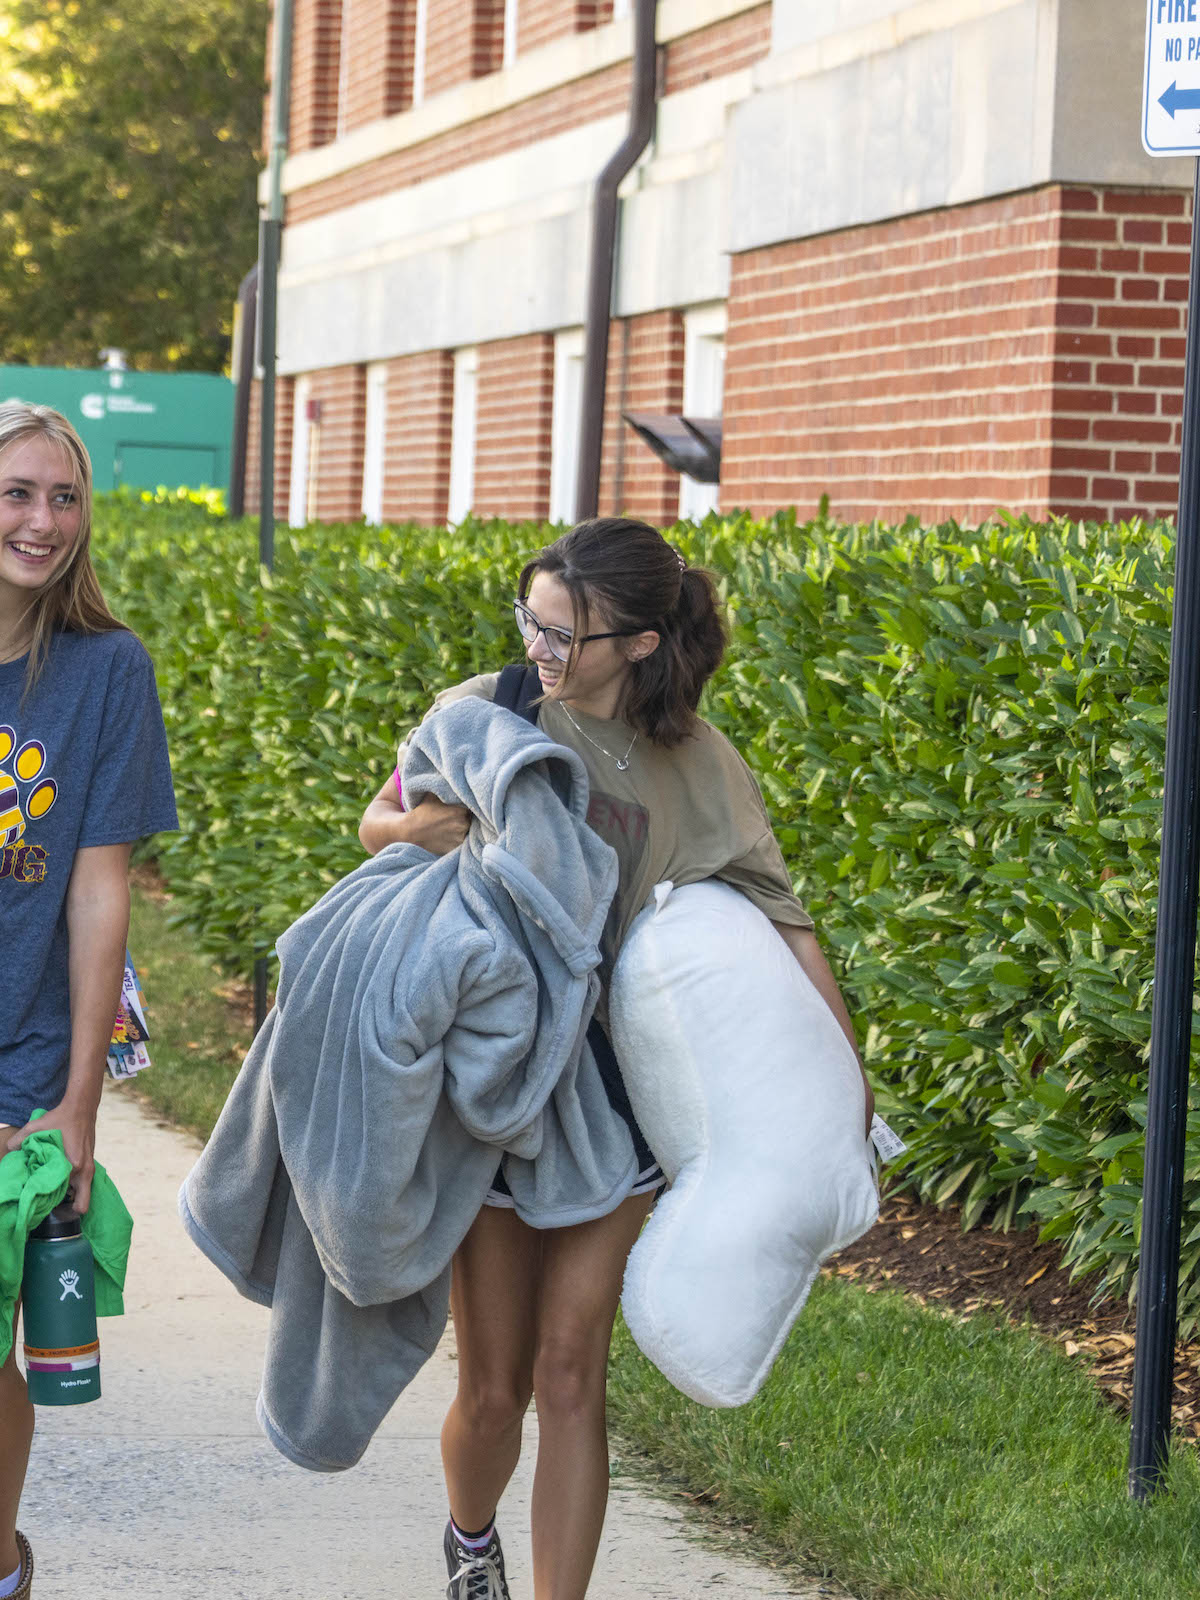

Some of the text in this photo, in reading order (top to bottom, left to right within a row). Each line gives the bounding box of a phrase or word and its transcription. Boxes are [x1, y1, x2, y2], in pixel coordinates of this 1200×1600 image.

[1157, 0, 1196, 24] FIRE
[1166, 38, 1182, 62] NO
[124, 971, 134, 991] TEAM
